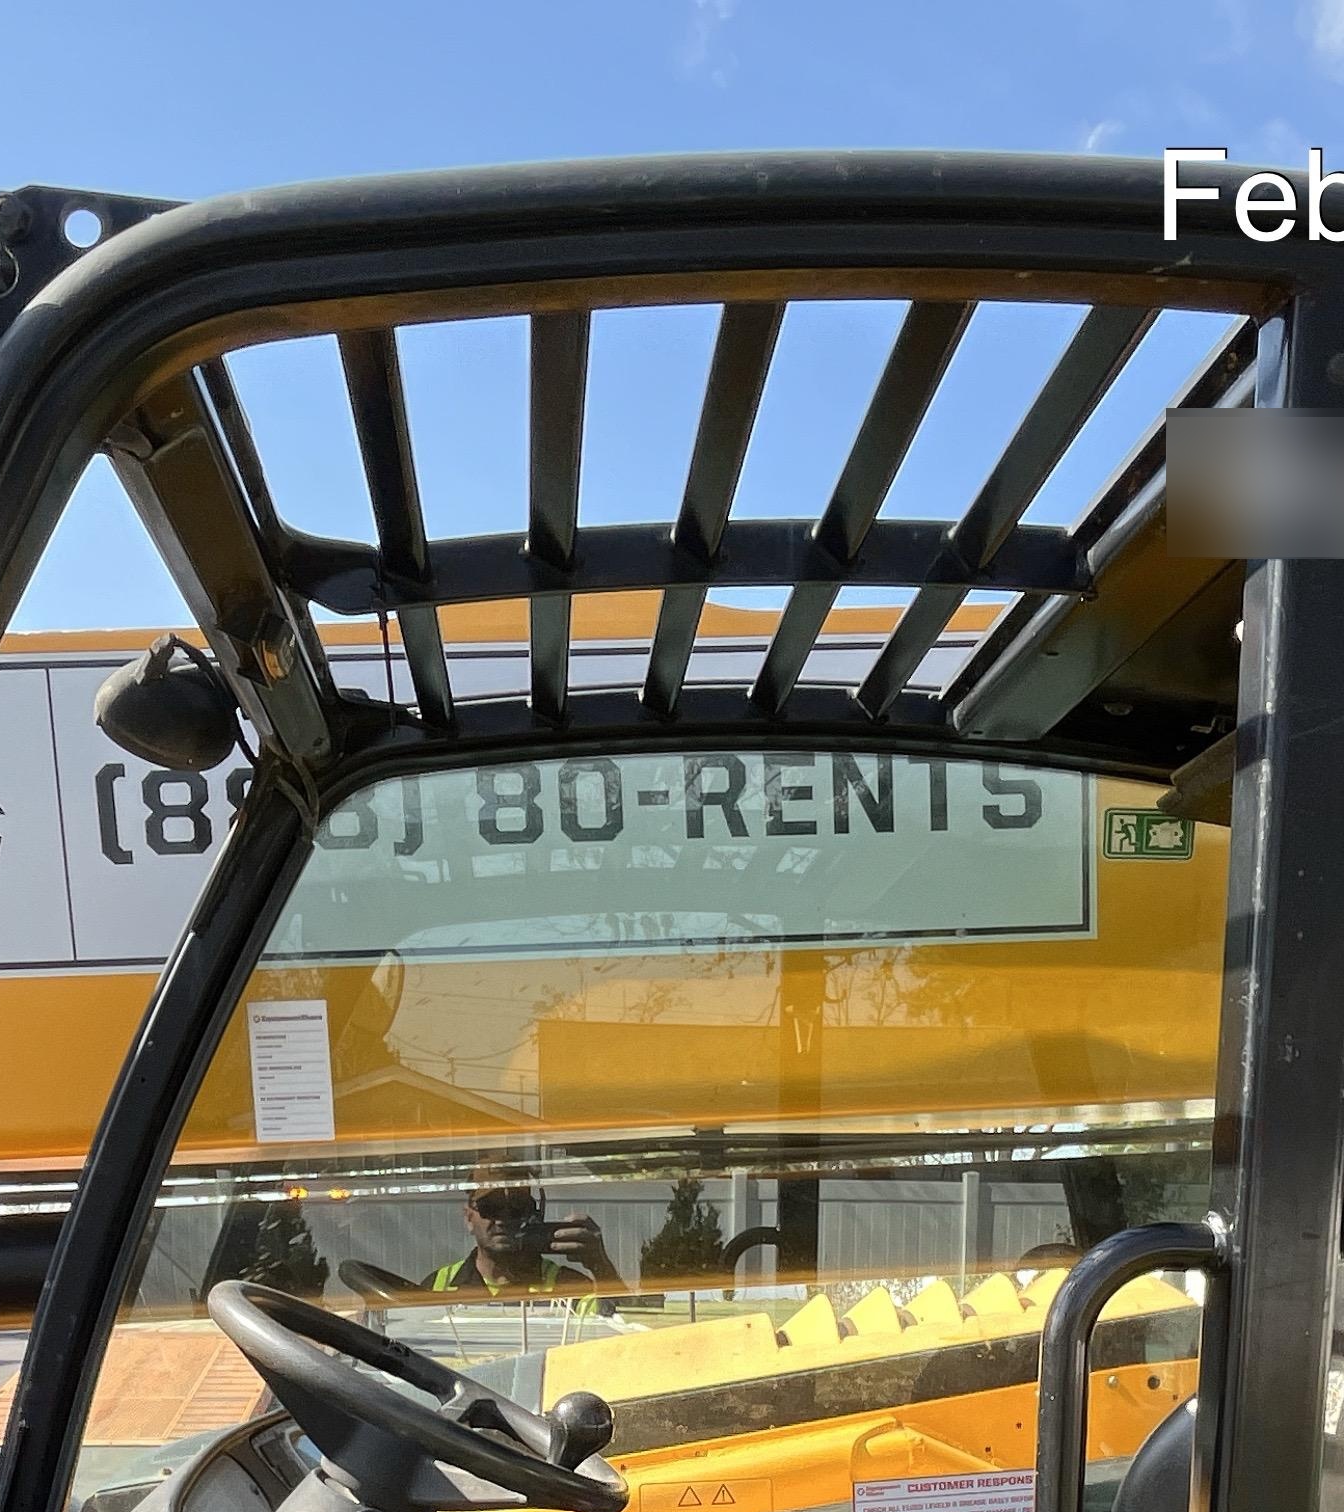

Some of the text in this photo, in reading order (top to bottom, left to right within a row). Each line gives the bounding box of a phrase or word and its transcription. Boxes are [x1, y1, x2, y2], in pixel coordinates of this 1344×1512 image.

[94, 752, 1043, 864] (88) 80-RENTS
[907, 1479, 974, 1493] CUSTOMER
